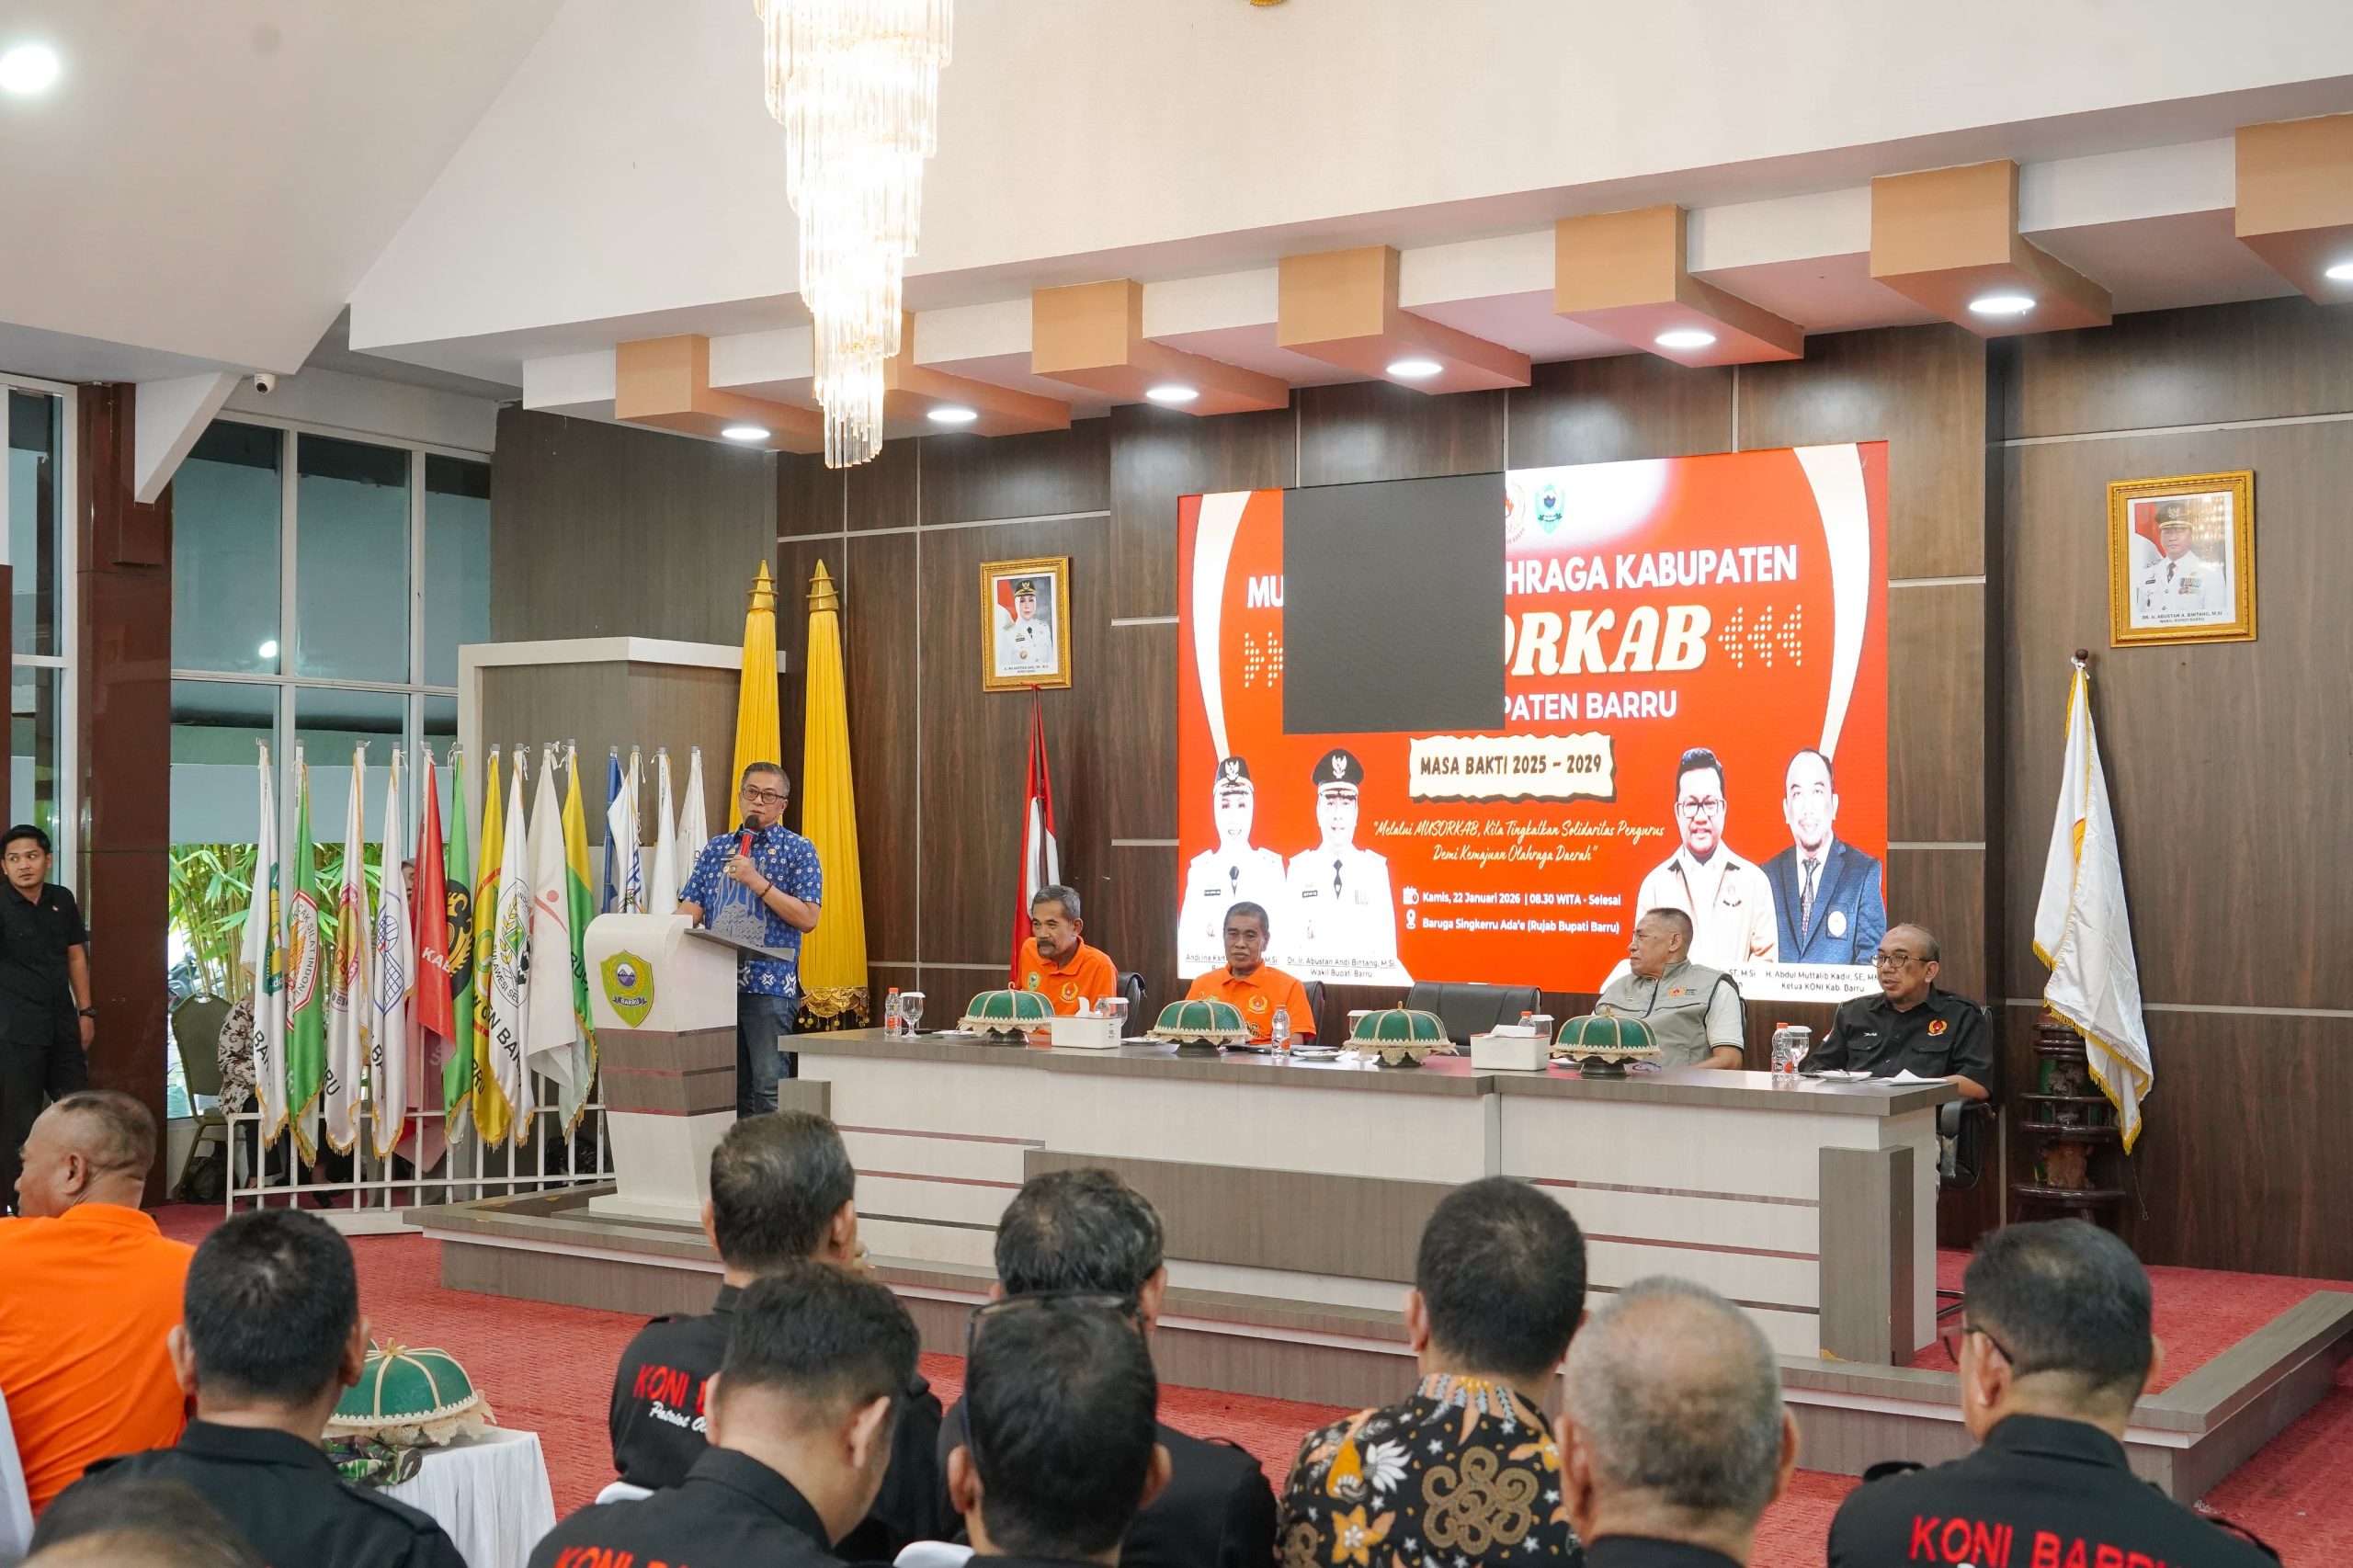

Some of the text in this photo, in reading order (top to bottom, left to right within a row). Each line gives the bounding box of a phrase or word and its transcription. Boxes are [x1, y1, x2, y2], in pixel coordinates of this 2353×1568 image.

[1505, 544, 1797, 597] HRAGA KABUPATEN
[1586, 689, 1677, 720] BARRU
[1420, 756, 1460, 775] MASA
[1465, 756, 1507, 775] BAKTI
[1513, 755, 1547, 774] 2025
[1566, 754, 1602, 773] 2029
[1414, 819, 1481, 837] MUSORKAB,
[1483, 820, 1505, 836] Kita
[1506, 820, 1560, 844] Tingkatkan
[1561, 820, 1615, 836] Solidaritas
[1617, 820, 1665, 846] Pengurus
[1433, 844, 1458, 861] Demi
[1460, 845, 1507, 868] Kemajuan
[1508, 845, 1553, 869] Olahraga
[1423, 892, 1452, 904] Kamis,
[1453, 893, 1463, 903] 22
[1465, 893, 1498, 903] Januari
[1499, 893, 1521, 904] 2026
[1529, 893, 1553, 905] 08.30
[1556, 894, 1582, 905] WITA
[1588, 894, 1621, 906] Selesai
[1422, 917, 1454, 931] Baruga
[1455, 917, 1499, 932] Singkerru
[1527, 919, 1557, 933] (Rujab
[1558, 920, 1589, 934] Bupati
[1590, 921, 1620, 935] Barru)
[1186, 953, 1199, 961] Andi
[1200, 953, 1211, 961] Ina
[1212, 954, 1228, 962] Kart
[1287, 956, 1296, 964] Dr.
[1306, 957, 1334, 966] Abustan
[1335, 958, 1350, 966] Andi
[1351, 958, 1380, 968] Bintang,
[1311, 968, 1373, 978] Wakil Bupati Barru
[1775, 971, 1796, 979] Abdul
[1798, 971, 1829, 980] Muttalib
[1830, 972, 1853, 982] Kadir,
[1854, 973, 1866, 982] SE,
[1781, 982, 1865, 993] Ketua KONI Kab. Barru
[632, 1363, 691, 1408] KONI
[1909, 1515, 2014, 1568] KONI
